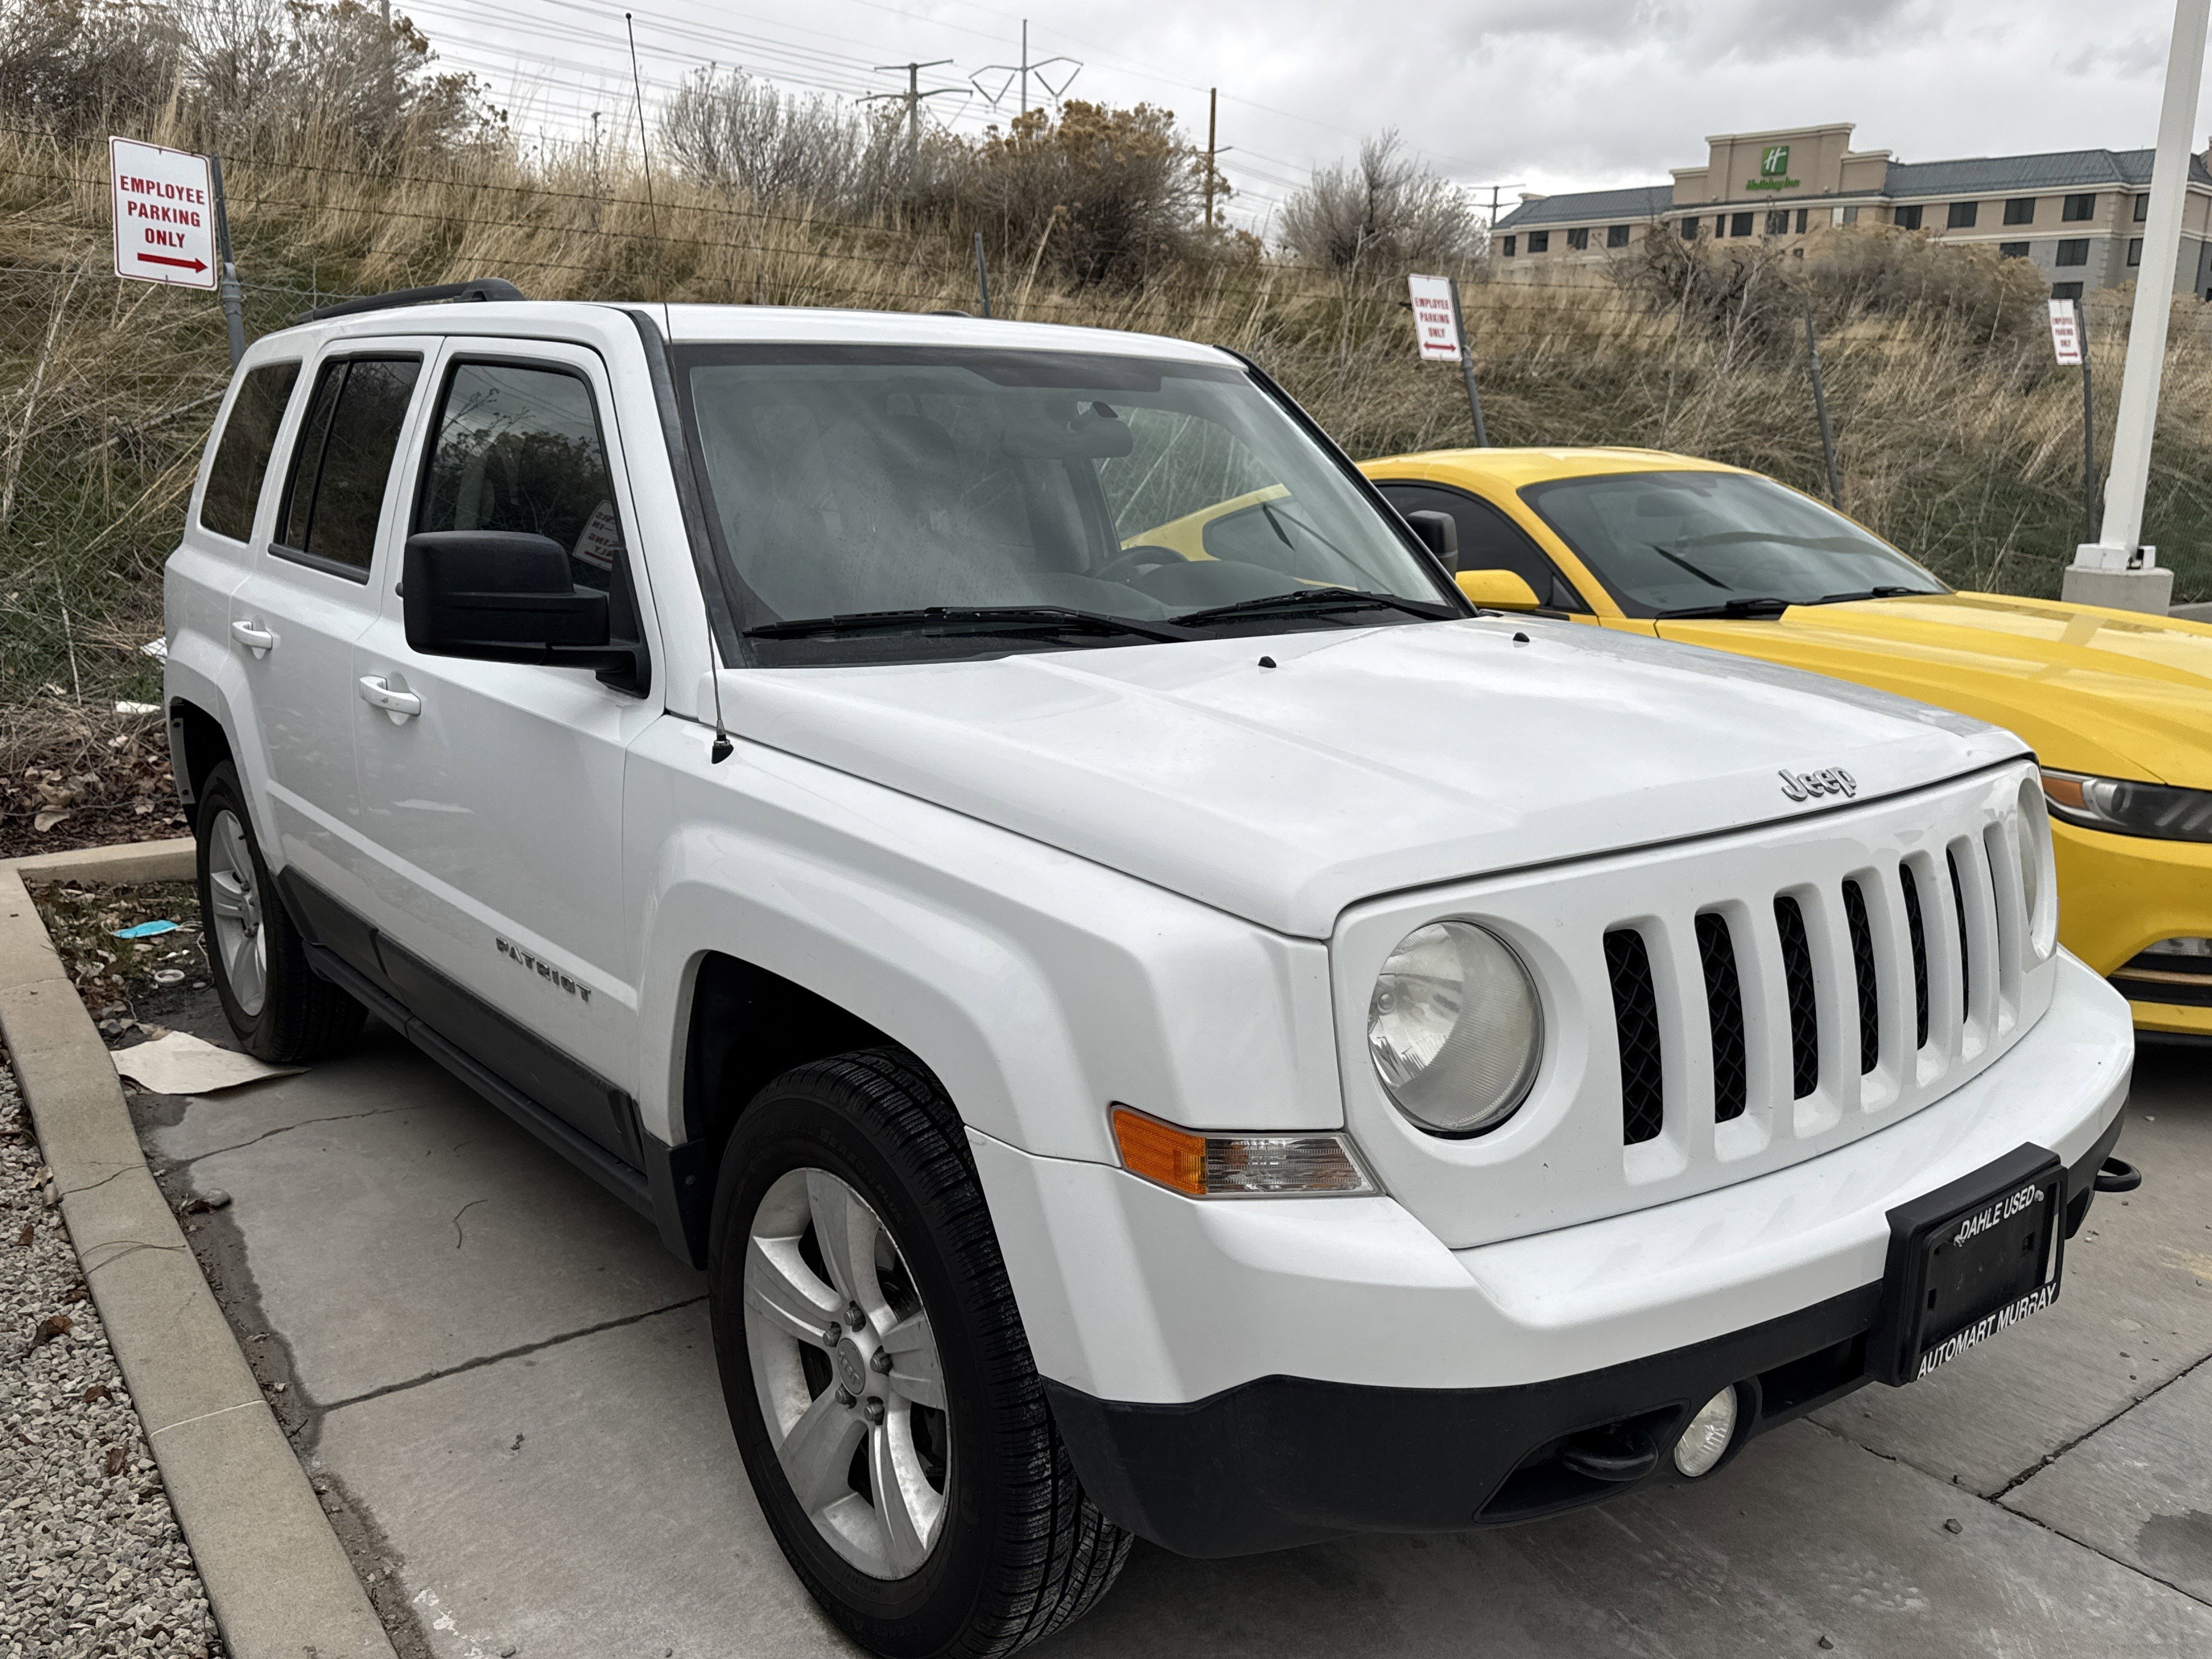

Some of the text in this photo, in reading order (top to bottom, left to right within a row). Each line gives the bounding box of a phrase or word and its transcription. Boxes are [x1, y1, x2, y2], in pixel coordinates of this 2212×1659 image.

[120, 175, 205, 205] EMPLOYEE
[127, 200, 201, 227] PARKING
[144, 228, 185, 249] ONLY
[1414, 297, 1449, 310] EMPLOYEE
[1419, 312, 1449, 324] PARKING
[1427, 327, 1445, 338] ONLY
[1778, 766, 1857, 802] Jeep
[496, 936, 591, 1002] PATRIOT
[1959, 1183, 2035, 1240] DAHLE USED
[1916, 1282, 2057, 1380] AUTOMART MURRAY
